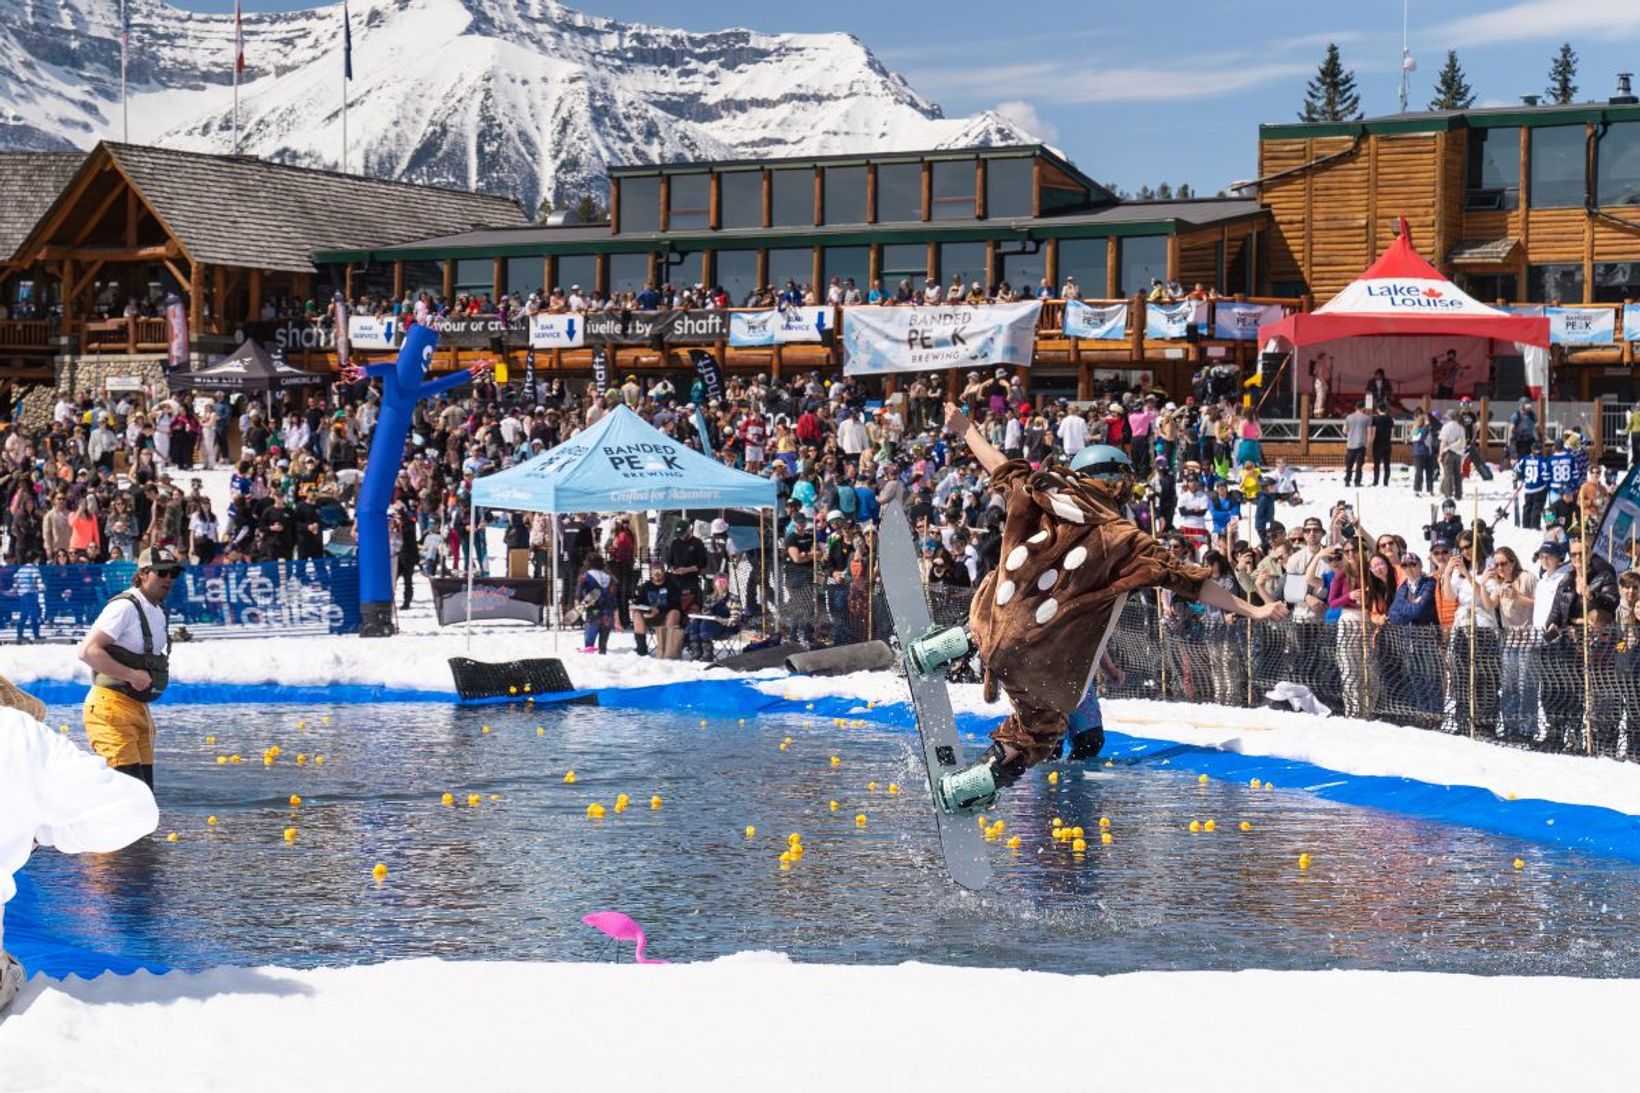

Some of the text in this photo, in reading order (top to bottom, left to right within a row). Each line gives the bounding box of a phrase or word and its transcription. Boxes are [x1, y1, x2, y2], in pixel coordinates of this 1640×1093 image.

[1367, 284, 1420, 297] Lake
[1390, 297, 1463, 309] Louise
[470, 321, 485, 331] or
[674, 315, 727, 335] shaft.
[908, 311, 971, 327] BANDED
[636, 321, 653, 336] by
[911, 351, 960, 363] BREWING
[603, 443, 676, 456] BANDED
[622, 471, 684, 479] BREWING
[1524, 465, 1538, 483] 91
[1552, 464, 1571, 482] 88
[185, 572, 274, 605] Lake
